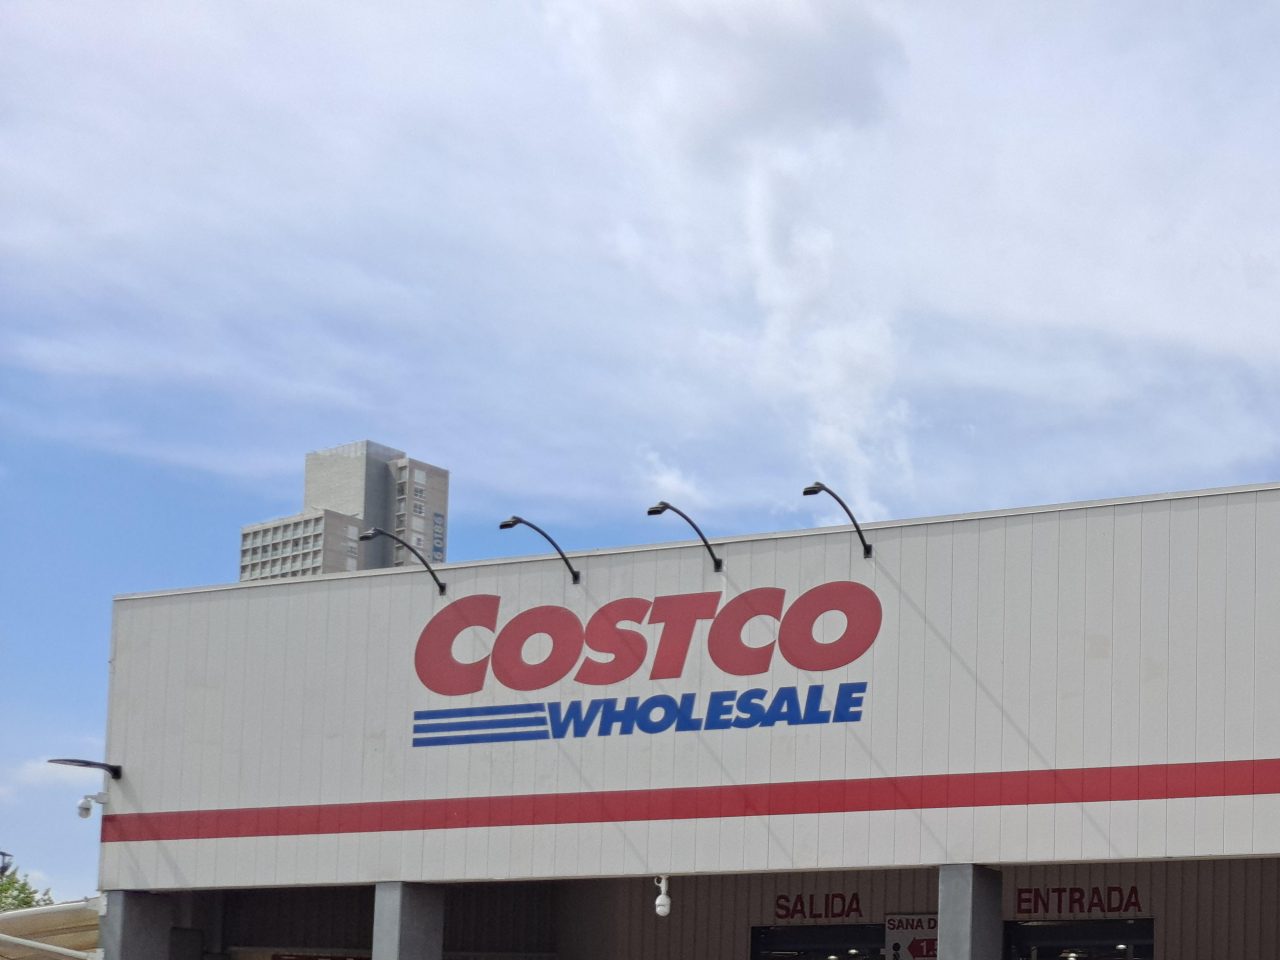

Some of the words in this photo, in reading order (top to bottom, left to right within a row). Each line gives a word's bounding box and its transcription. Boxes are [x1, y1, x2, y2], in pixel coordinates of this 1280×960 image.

[414, 580, 883, 696] COSTCO
[547, 681, 868, 739] WHOLESALE
[775, 892, 863, 919] SALIDA
[1016, 886, 1142, 915] ENTRADA
[887, 918, 924, 930] SANA
